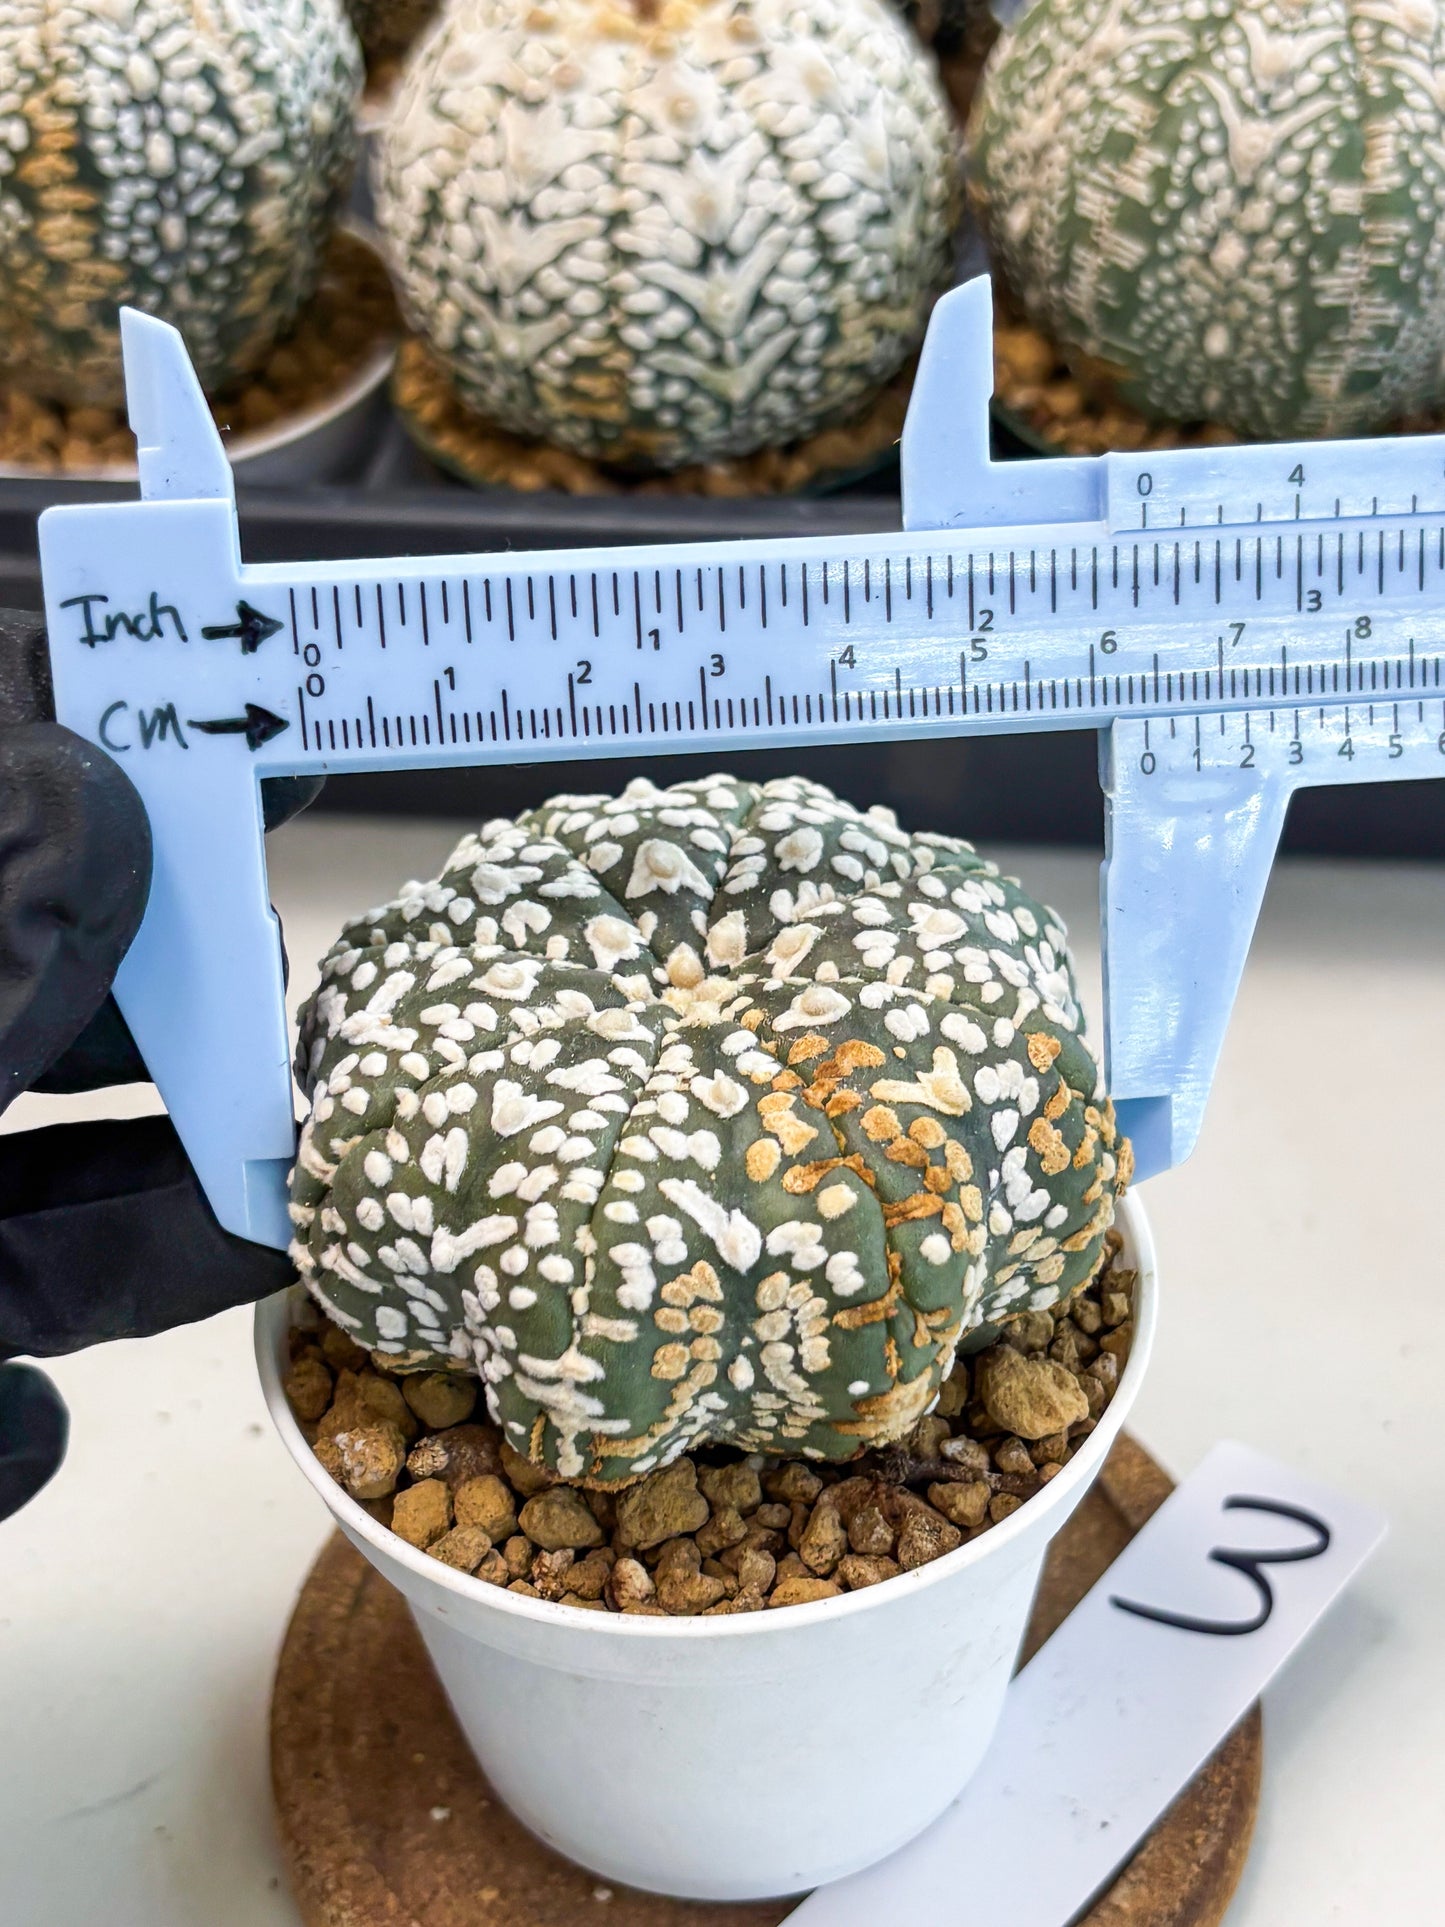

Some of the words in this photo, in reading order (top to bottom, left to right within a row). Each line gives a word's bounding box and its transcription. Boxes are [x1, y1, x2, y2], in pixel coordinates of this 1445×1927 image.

[1137, 472, 1153, 496] 0
[1288, 464, 1305, 487] 4
[59, 591, 188, 648] Inch
[304, 643, 321, 667] 0
[648, 629, 660, 650] 1
[978, 609, 994, 632] 2
[1307, 589, 1322, 613] 3
[306, 674, 325, 697] 0
[444, 666, 455, 690] 1
[577, 660, 592, 684] 2
[710, 654, 725, 676] 3
[838, 645, 856, 669] 4
[971, 638, 988, 662] 5
[1100, 630, 1117, 655] 6
[1229, 622, 1246, 647] 7
[1355, 616, 1372, 640] 8
[1140, 752, 1156, 775] 0
[1193, 747, 1201, 772] 1
[1239, 744, 1255, 769] 2
[1289, 741, 1304, 765] 3
[1337, 738, 1355, 761] 4
[1388, 734, 1402, 759] 5
[1108, 1493, 1330, 1636] 3
